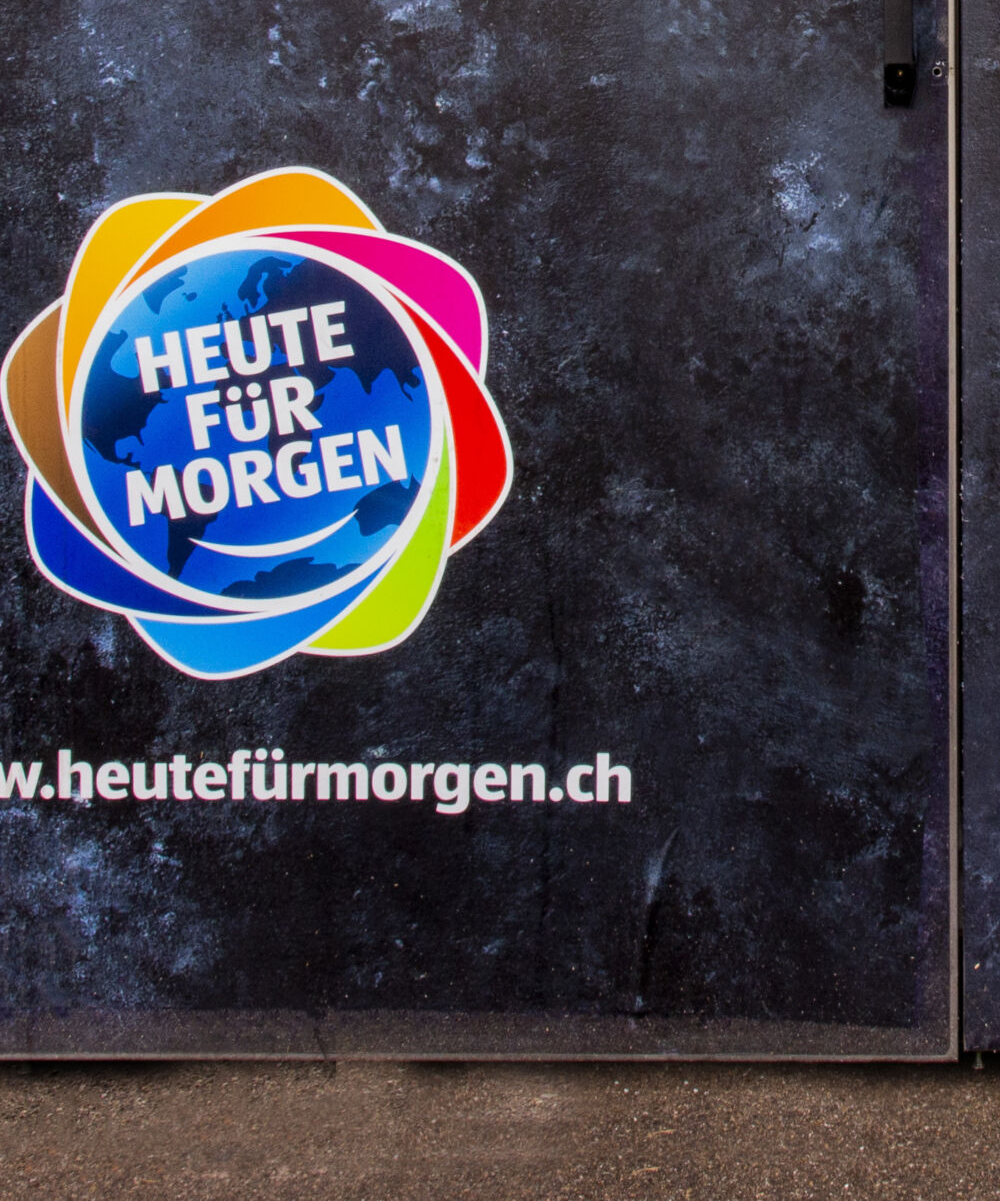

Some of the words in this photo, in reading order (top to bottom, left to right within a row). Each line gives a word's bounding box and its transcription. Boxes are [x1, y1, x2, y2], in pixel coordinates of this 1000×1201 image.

[135, 301, 355, 393] HEUTE
[186, 375, 323, 450] FÜR
[126, 424, 408, 527] MORGEN
[0, 748, 632, 814] w.heutefürmorgen.ch
